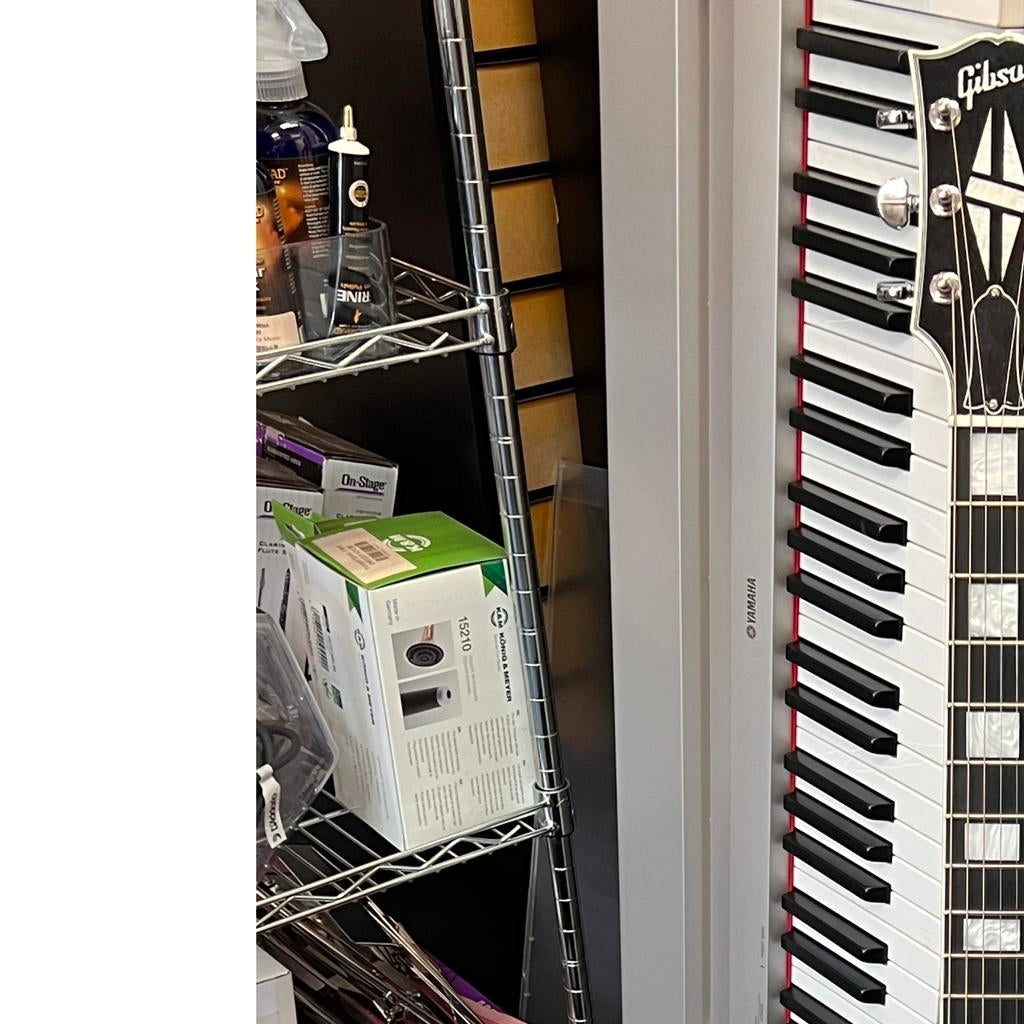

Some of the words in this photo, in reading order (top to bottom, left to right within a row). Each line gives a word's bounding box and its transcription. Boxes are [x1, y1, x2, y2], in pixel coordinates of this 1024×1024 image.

[341, 473, 387, 492] On-Stage
[495, 606, 505, 630] K&M
[746, 577, 757, 624] YAMAHA
[457, 615, 472, 652] 15210
[498, 632, 508, 662] KÖNIG
[504, 671, 513, 703] MEYER
